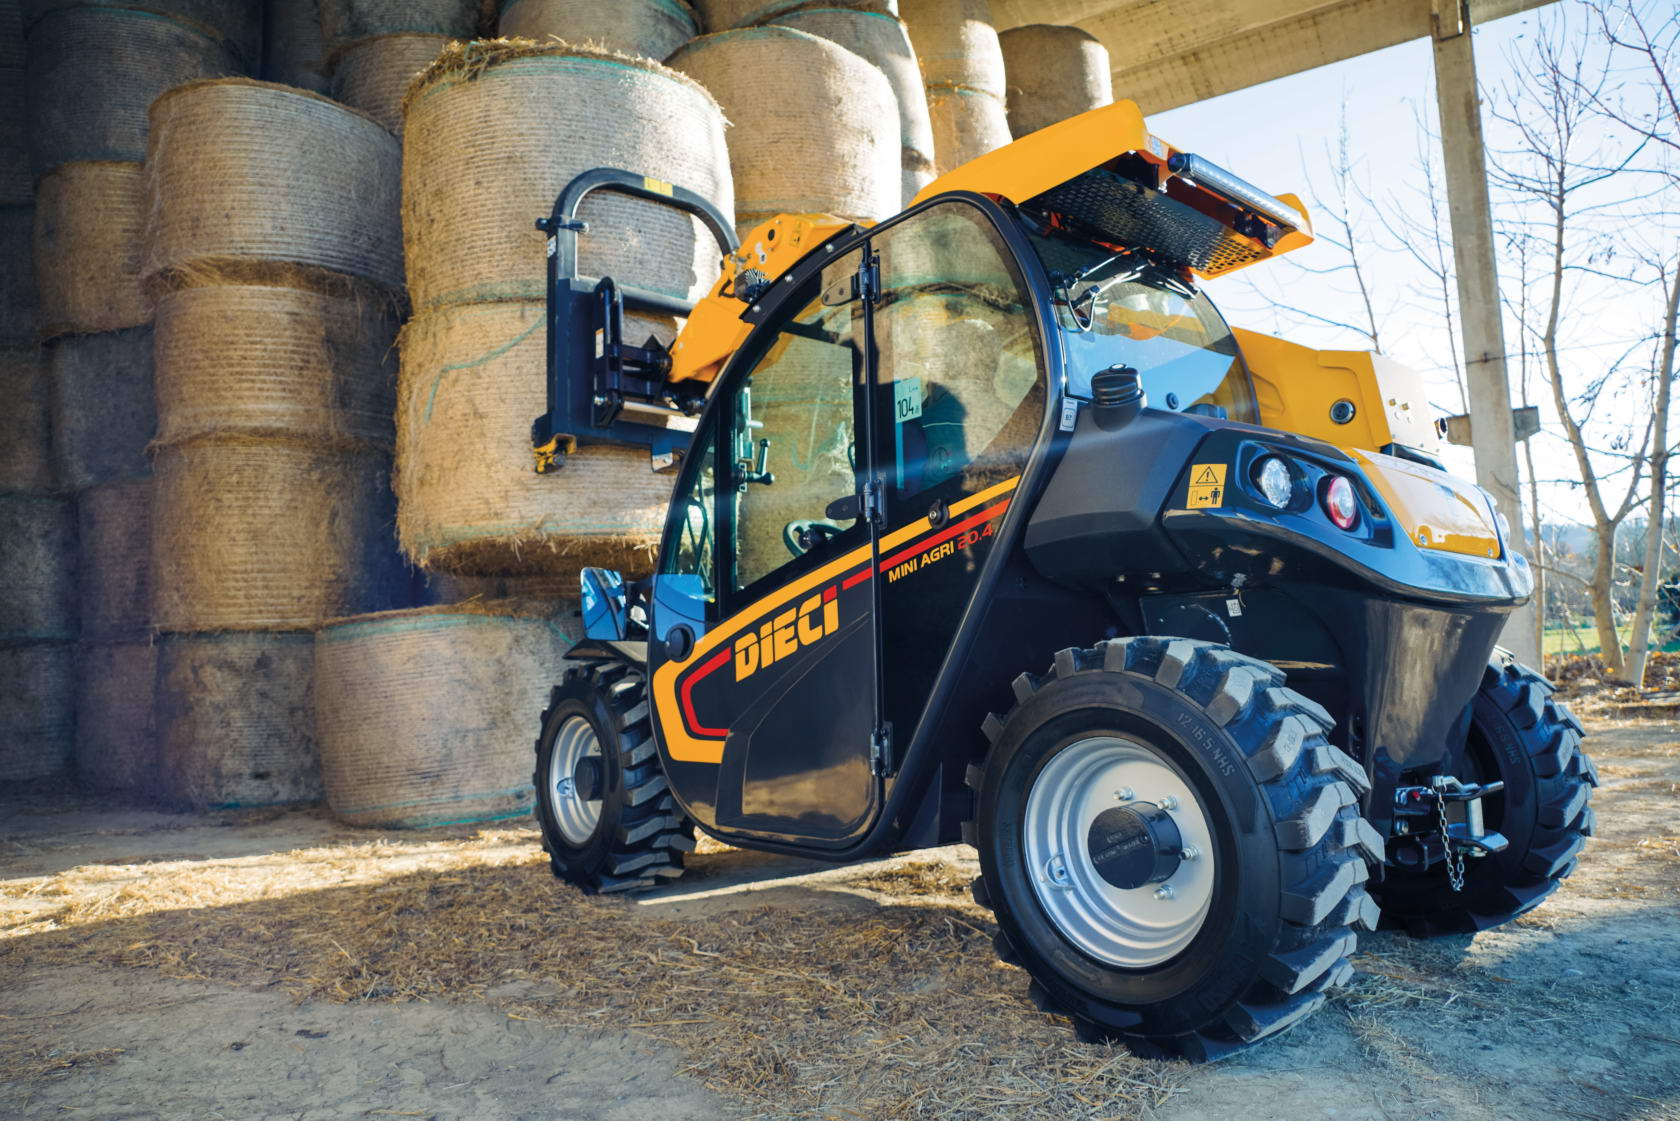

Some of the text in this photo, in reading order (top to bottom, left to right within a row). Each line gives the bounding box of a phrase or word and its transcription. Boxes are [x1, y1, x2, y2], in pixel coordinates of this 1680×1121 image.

[897, 397, 915, 419] 104
[888, 523, 994, 584] MINI AGRI 20.4
[734, 585, 840, 683] DIECI
[1212, 748, 1236, 777] NHS
